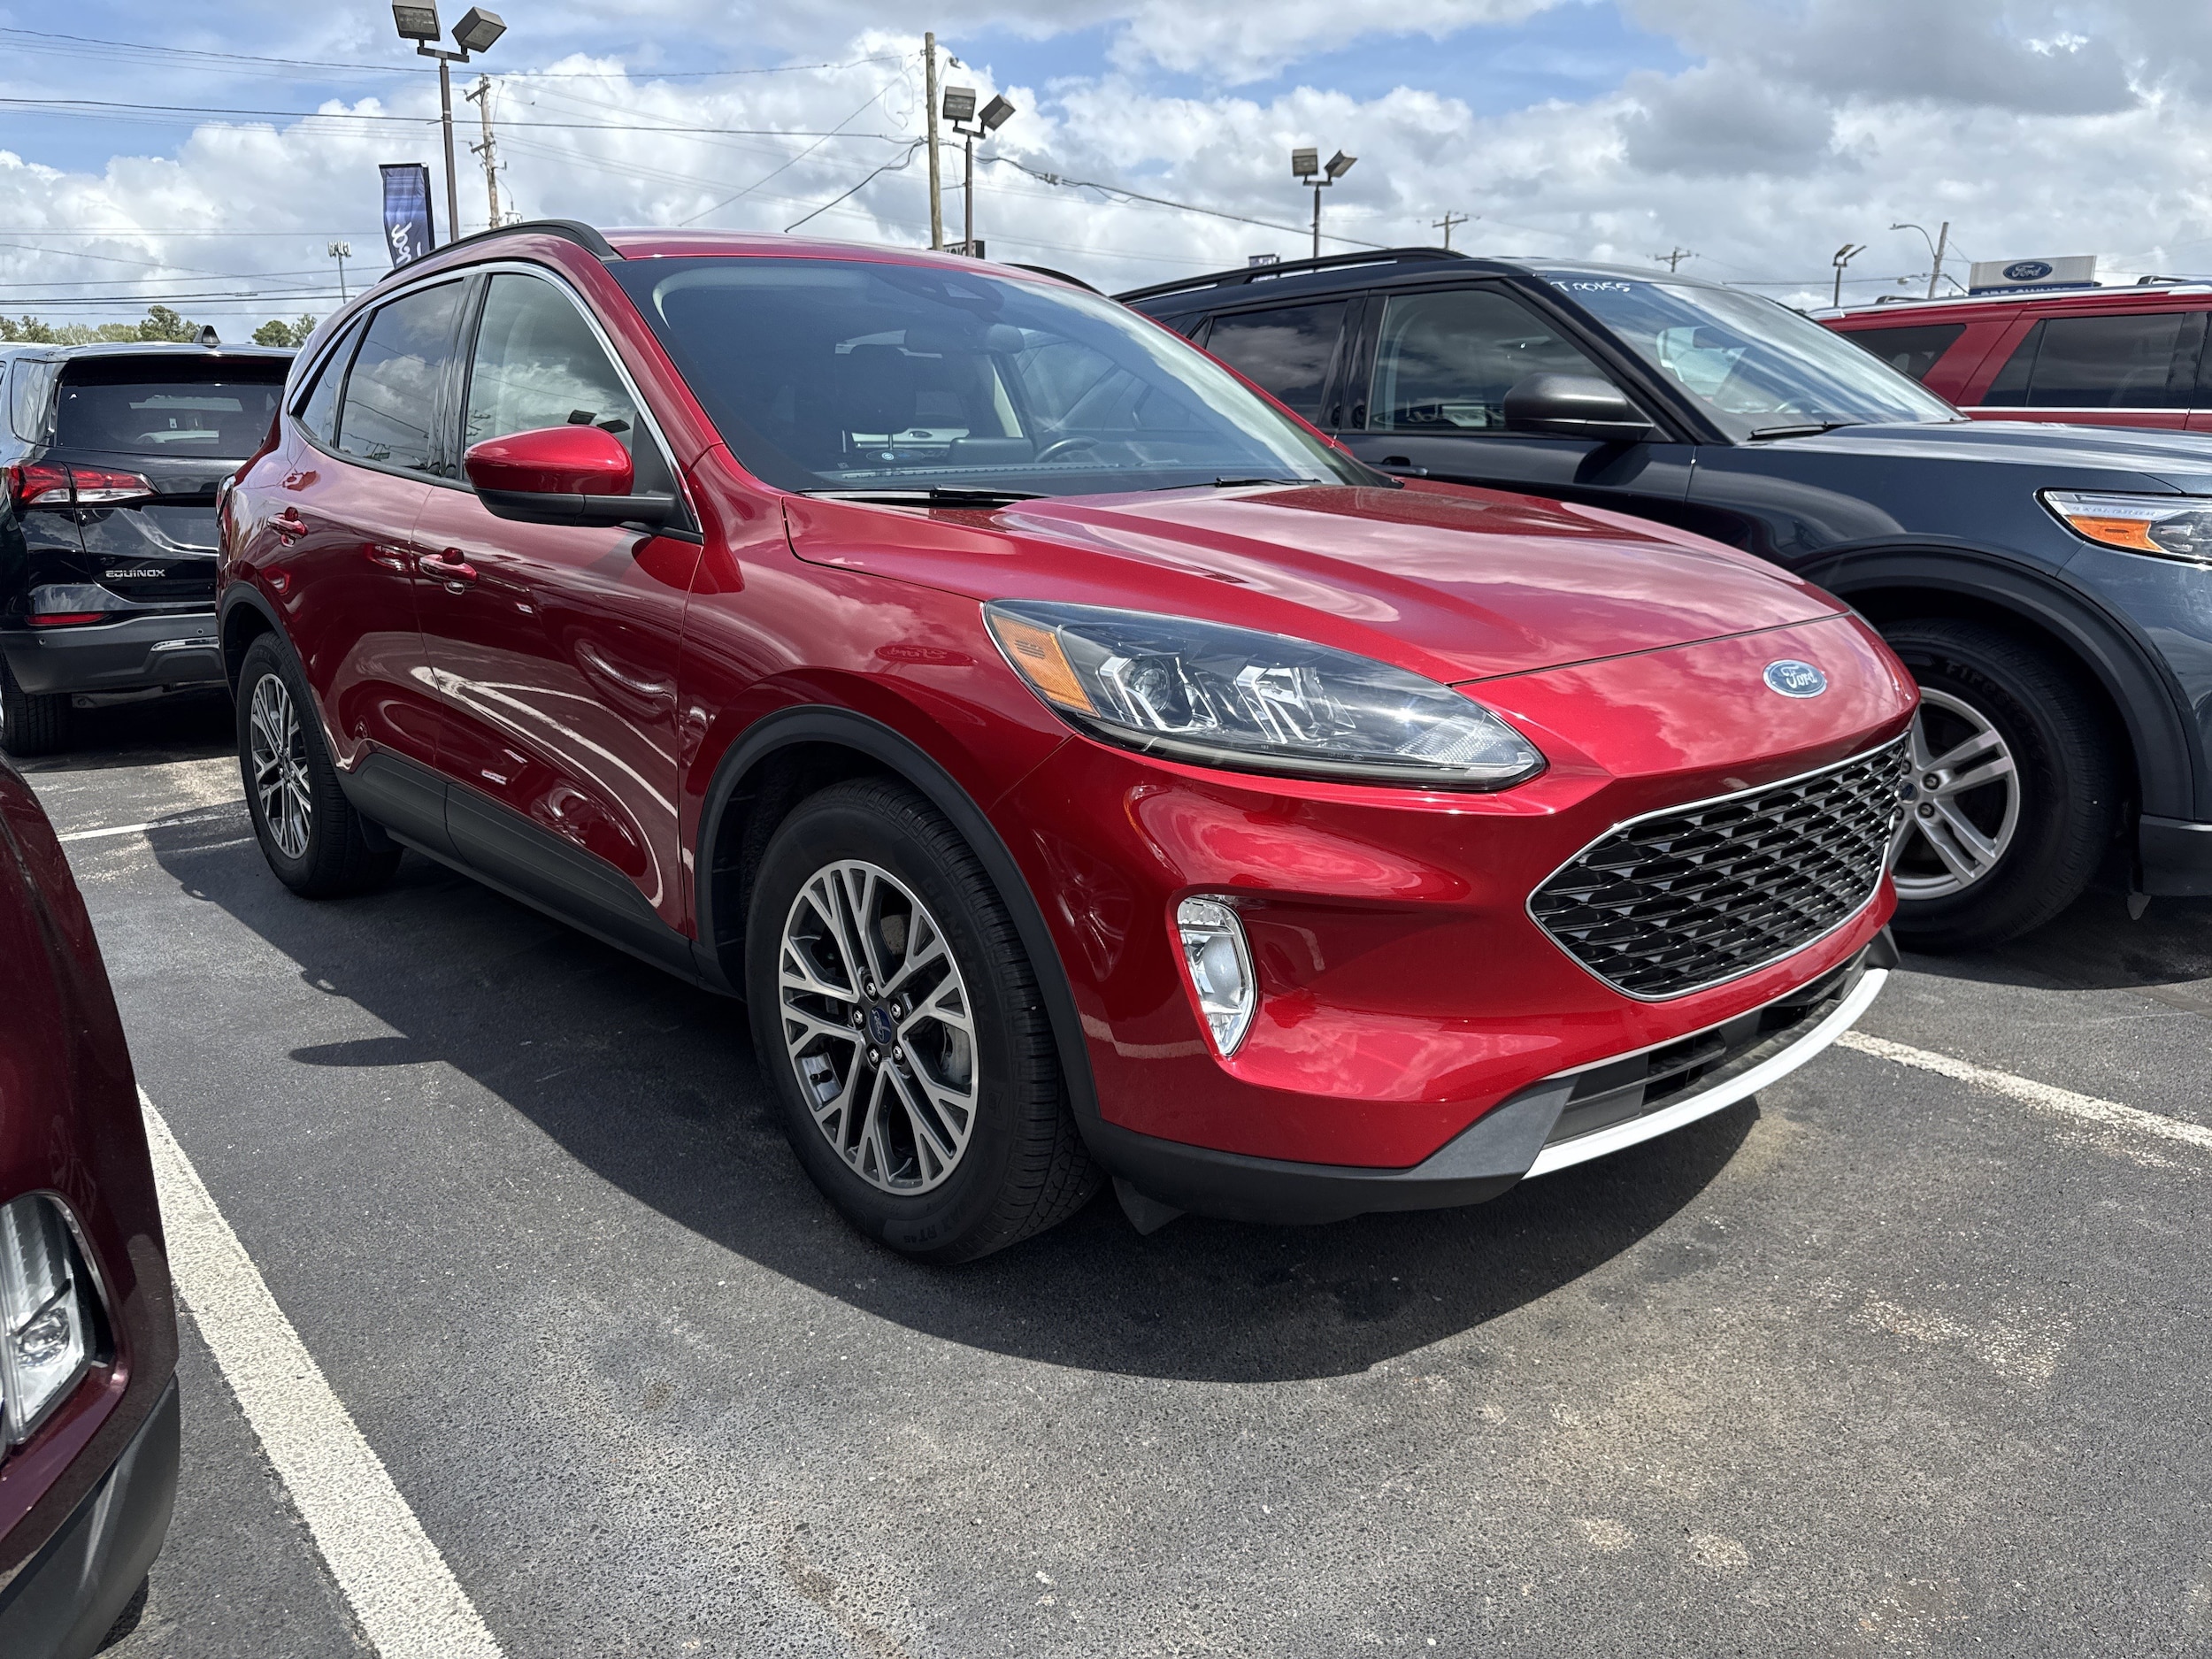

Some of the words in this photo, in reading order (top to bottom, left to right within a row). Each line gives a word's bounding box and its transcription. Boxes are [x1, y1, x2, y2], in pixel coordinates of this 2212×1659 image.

[2011, 265, 2042, 278] Ford
[105, 569, 165, 578] EQUINOX
[1780, 665, 1817, 688] Ford
